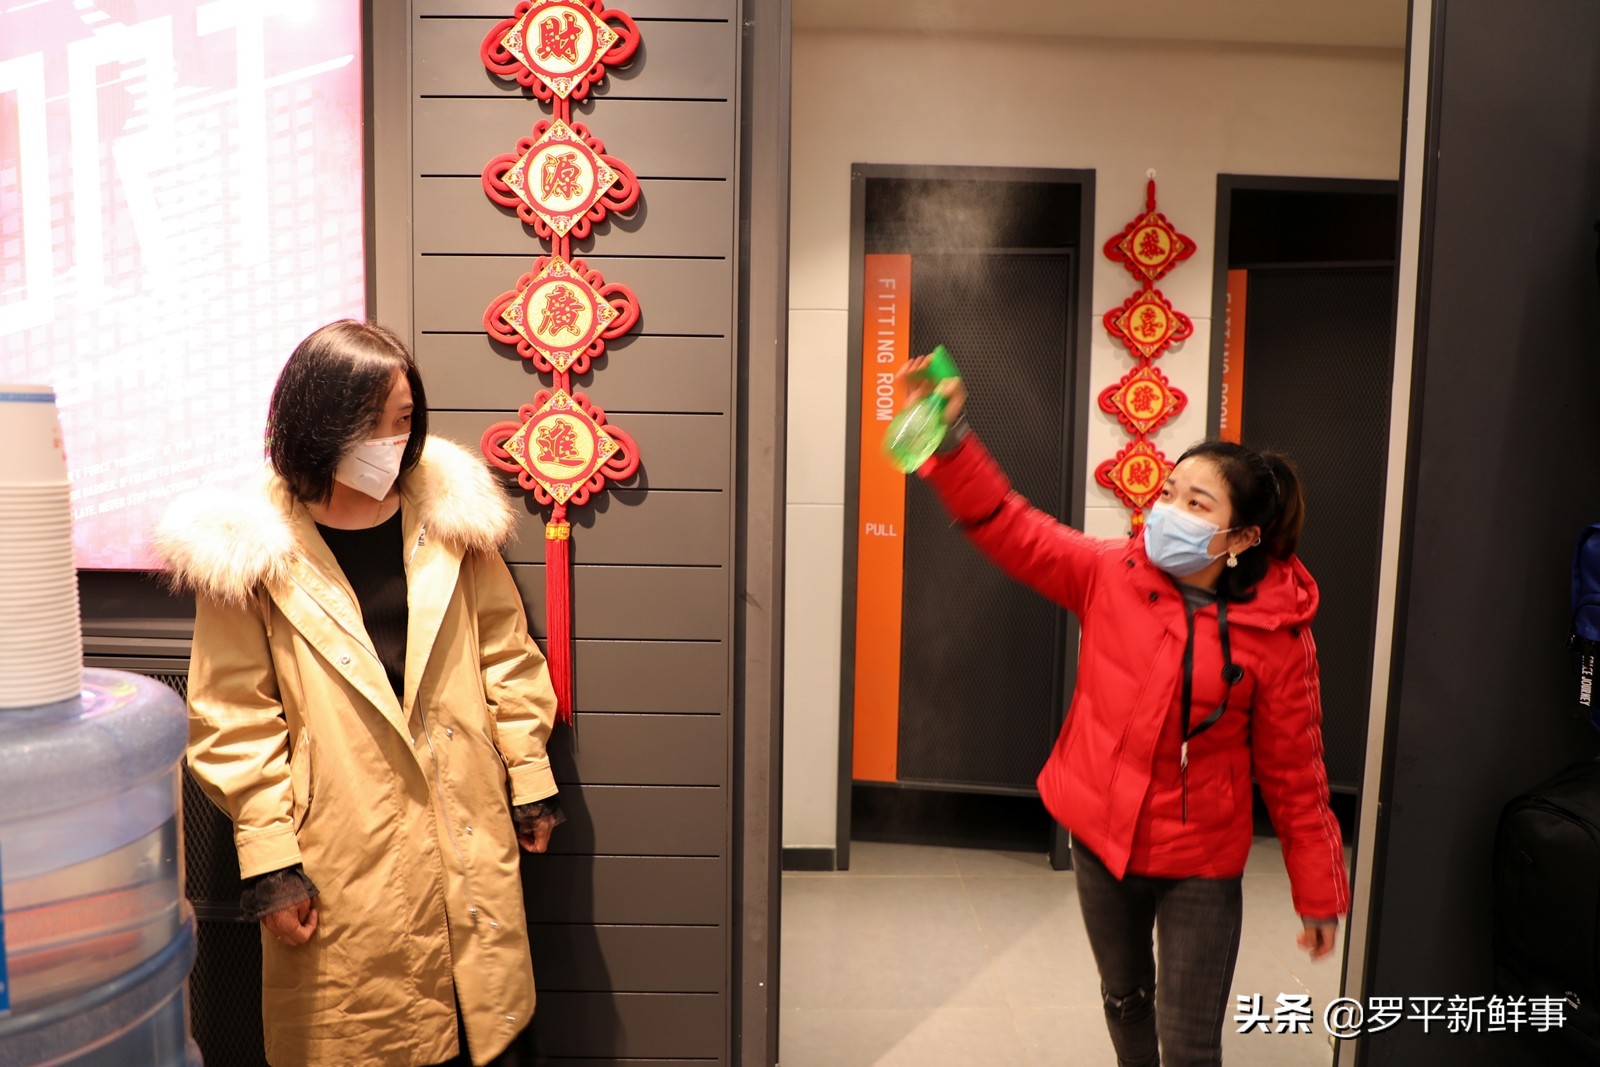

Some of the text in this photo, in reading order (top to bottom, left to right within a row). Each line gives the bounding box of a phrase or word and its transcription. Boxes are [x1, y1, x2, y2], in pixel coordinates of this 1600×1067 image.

[876, 278, 896, 421] FITTING ROOM
[865, 522, 897, 537] PULL
[1579, 676, 1593, 707] JOURNEY
